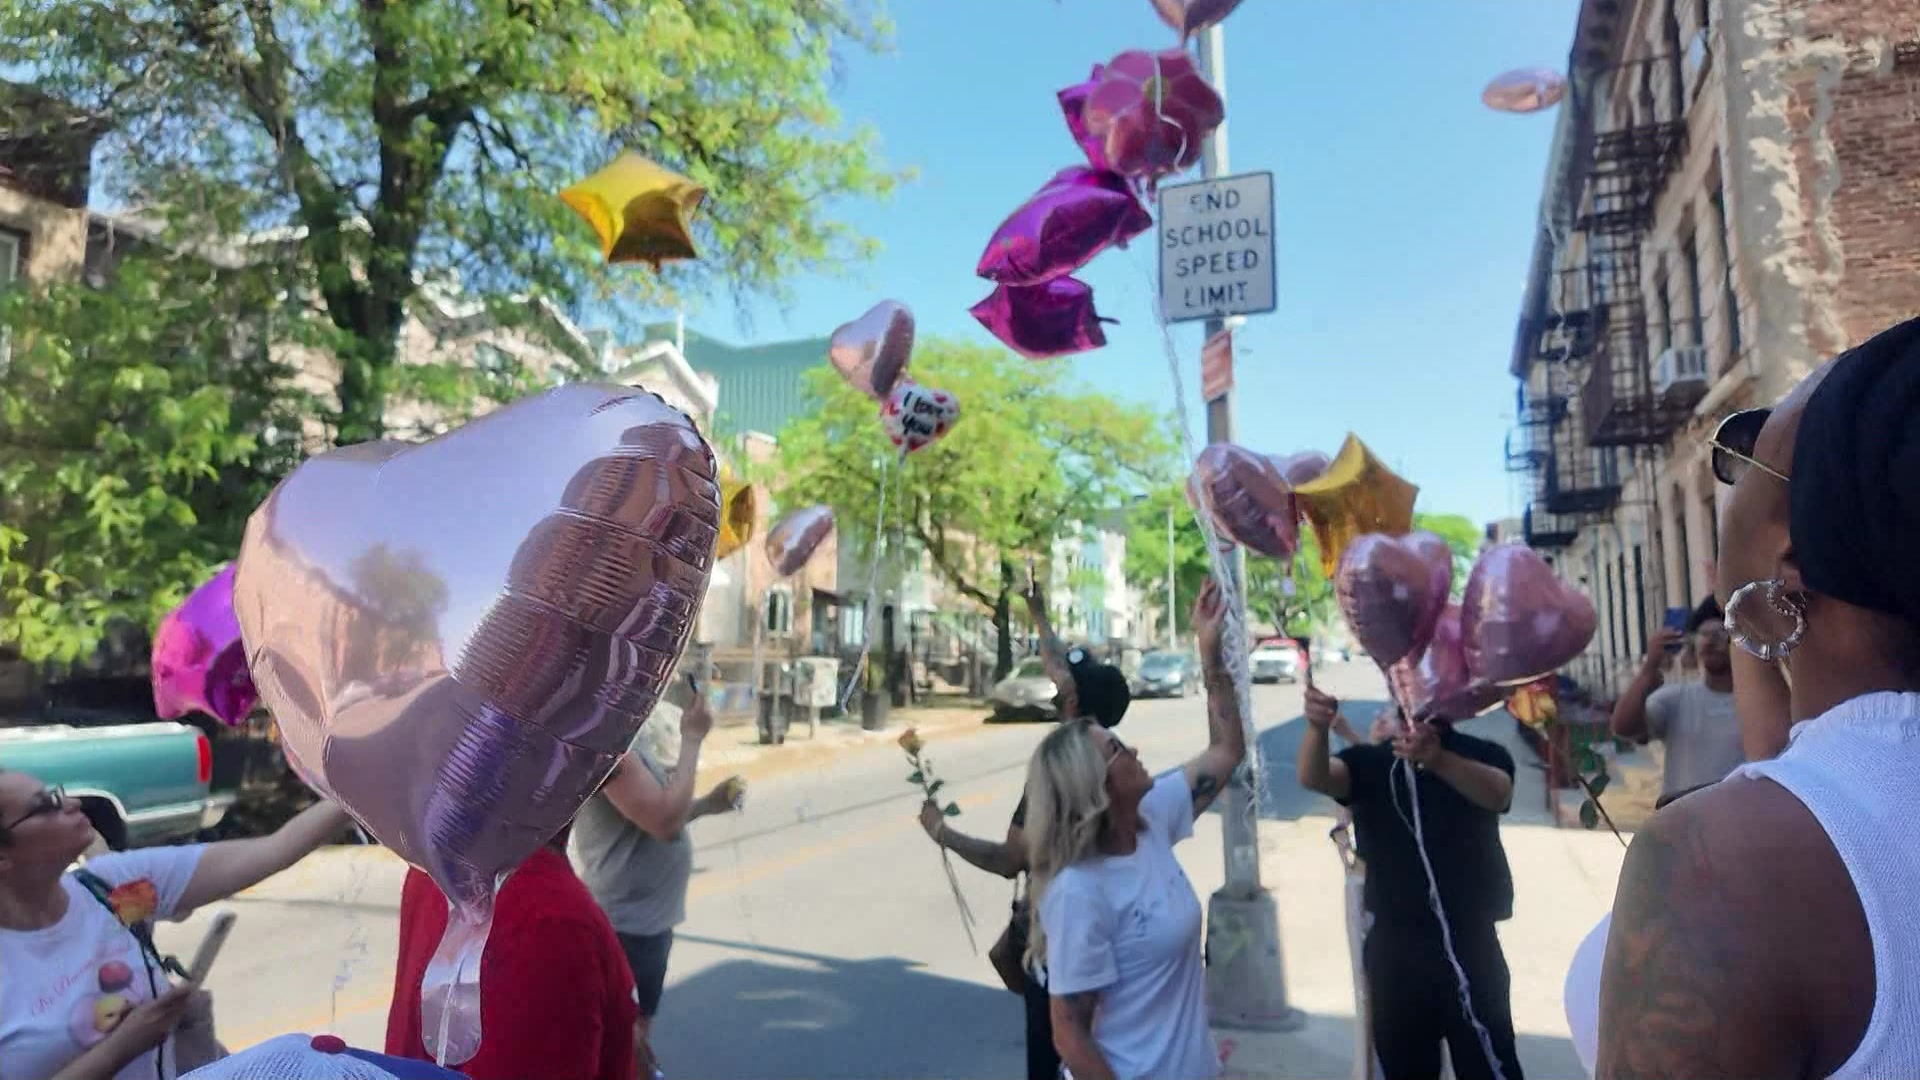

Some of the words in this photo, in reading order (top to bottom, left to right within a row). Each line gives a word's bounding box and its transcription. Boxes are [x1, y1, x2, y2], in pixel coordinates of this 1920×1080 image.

[1189, 188, 1241, 213] END
[1166, 217, 1269, 249] SCHOOL
[1175, 249, 1259, 278] SPEED
[1183, 281, 1249, 309] LIMIT
